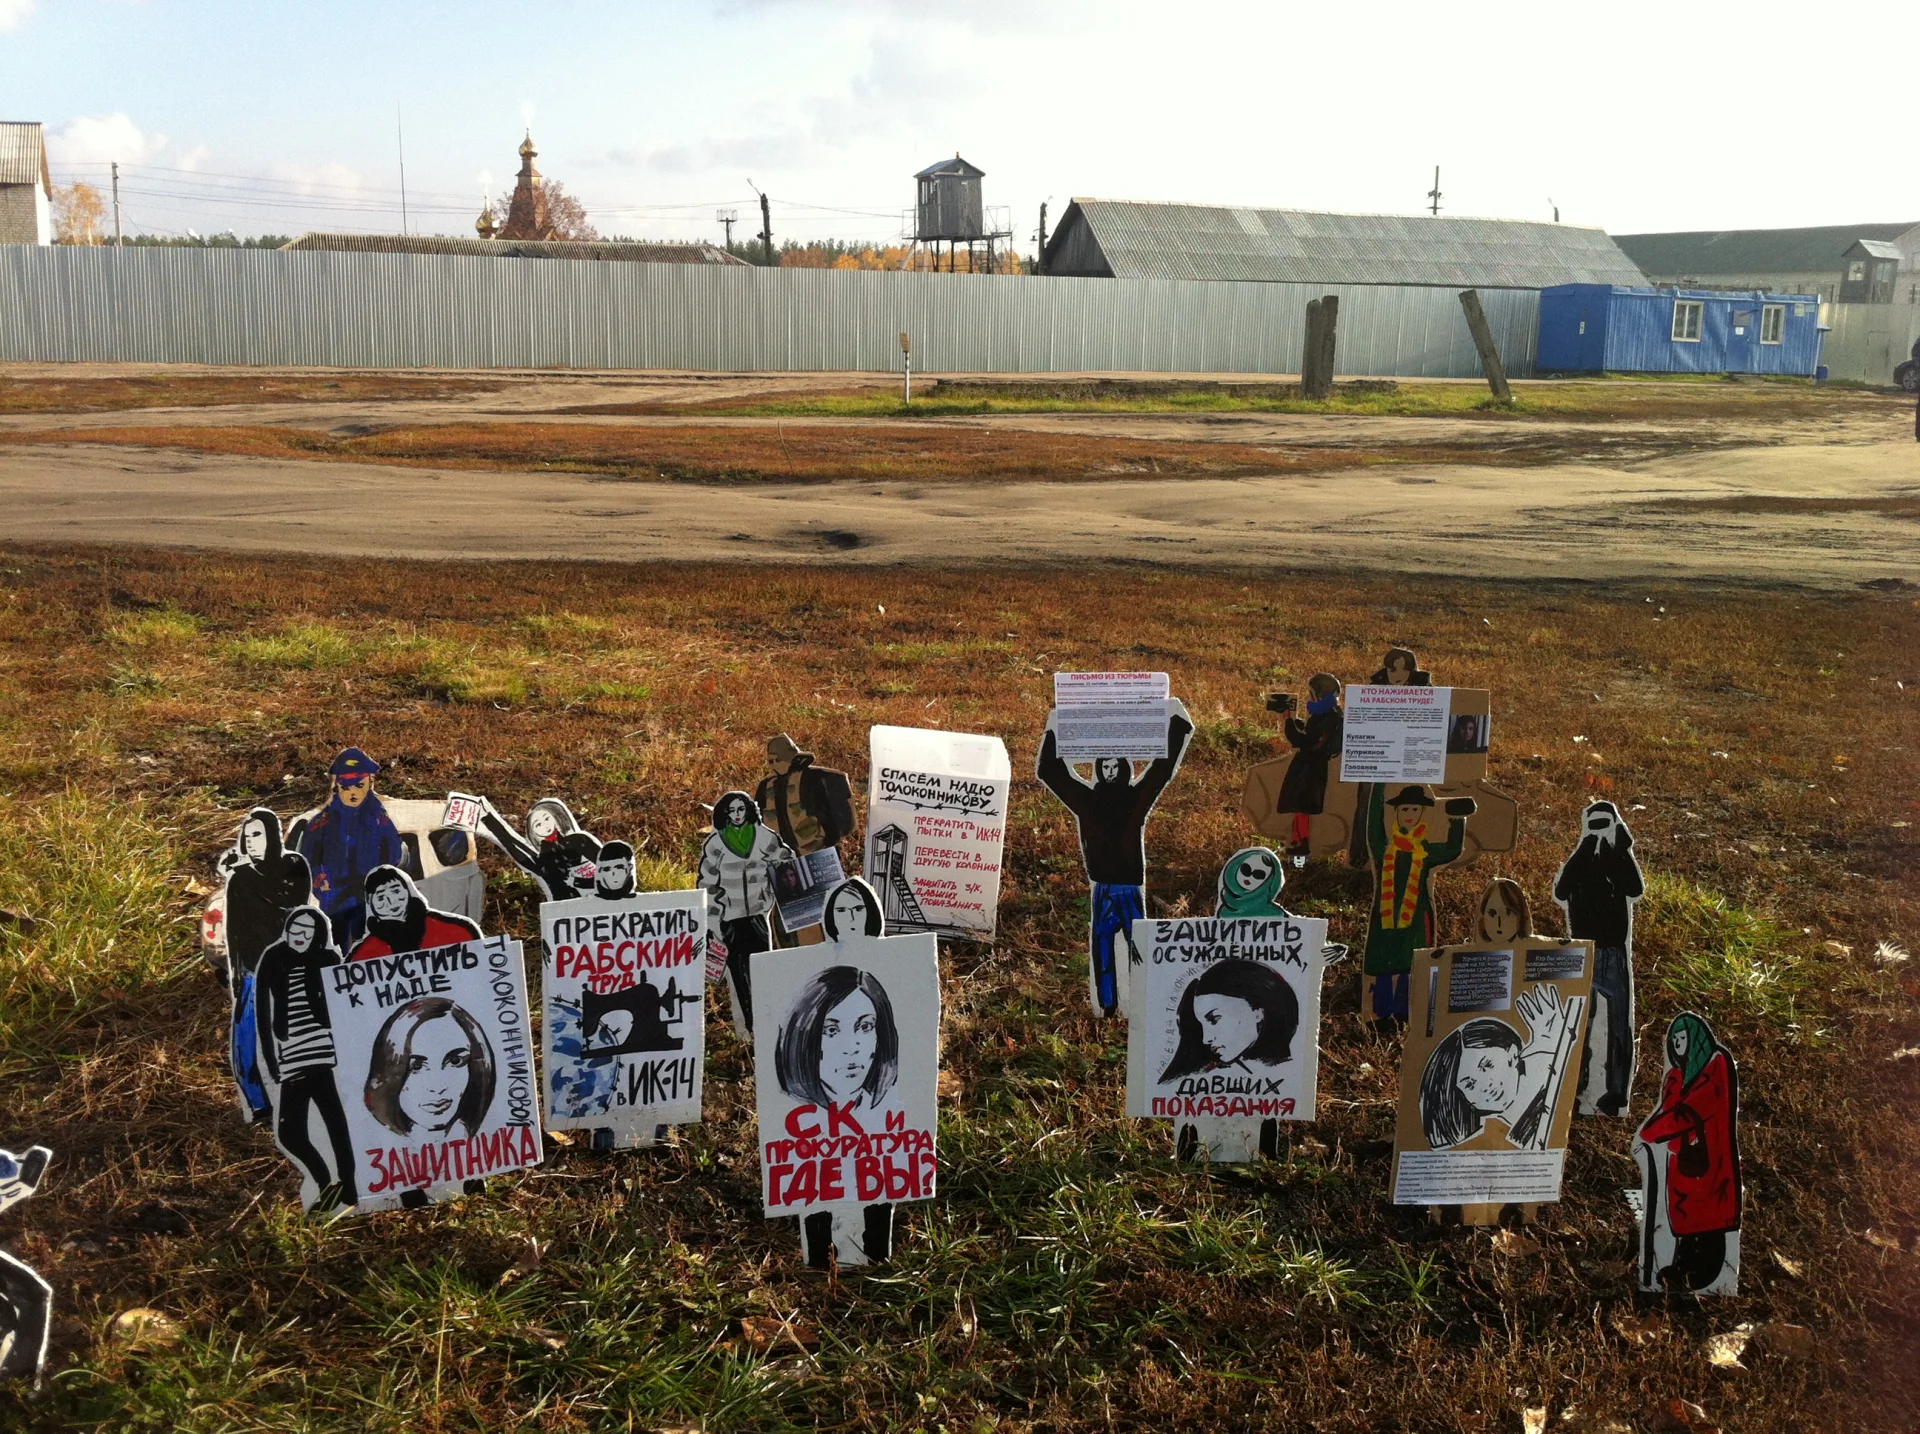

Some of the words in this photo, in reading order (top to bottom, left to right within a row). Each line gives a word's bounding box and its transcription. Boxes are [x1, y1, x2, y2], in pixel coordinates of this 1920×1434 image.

[1117, 672, 1152, 680] ТЮРЬМЫ
[1360, 688, 1377, 696] КТО
[1378, 688, 1434, 697] НАЖИВАЕТСЯ
[1360, 696, 1371, 704] НА
[1372, 697, 1407, 705] РАБСКОМ
[1408, 697, 1434, 706] ТРУДЕ?
[1346, 733, 1375, 741] Кулагин
[1345, 748, 1385, 757] Куприянов
[881, 767, 941, 788] СПАСЁМ
[950, 780, 995, 797] НАДЮ
[879, 779, 992, 810] ТОЛОКОННИКОВУ
[914, 816, 975, 830] ПРЕКРАТИТЬ
[916, 826, 952, 838] ПЫТКИ
[976, 826, 1001, 842] ИК-14
[914, 846, 970, 860] ПЕРЕВЕСТИ
[913, 857, 951, 868] ДРУГУЮ
[956, 861, 999, 872] КОЛОНИЮ
[912, 877, 957, 890] ЗАЩИТИТЬ
[913, 887, 958, 900] ДАВШИХ
[553, 909, 699, 945] ПРЕКРАТИТЬ
[1155, 919, 1302, 947] ЗАЩИТИТЬ
[556, 931, 694, 978] РАБСКИЙ
[333, 943, 478, 995] ДОПУСТИТЬ
[375, 974, 452, 1008] НАДЕ
[588, 971, 637, 994] ТРУД
[483, 935, 531, 1128] ТОЛОКОННИКОВОЙ
[1176, 1075, 1285, 1096] ДАВШИХ
[1152, 1095, 1296, 1117] ПОКАЗАНИЯ
[785, 1100, 864, 1139] СК
[886, 1110, 905, 1132] И
[765, 1129, 934, 1164] ПРОКУРАТУРА
[365, 1125, 538, 1194] ЗАЩИТНИКА
[768, 1157, 845, 1207] ГДЕ
[855, 1153, 937, 1201] ВЫ?
